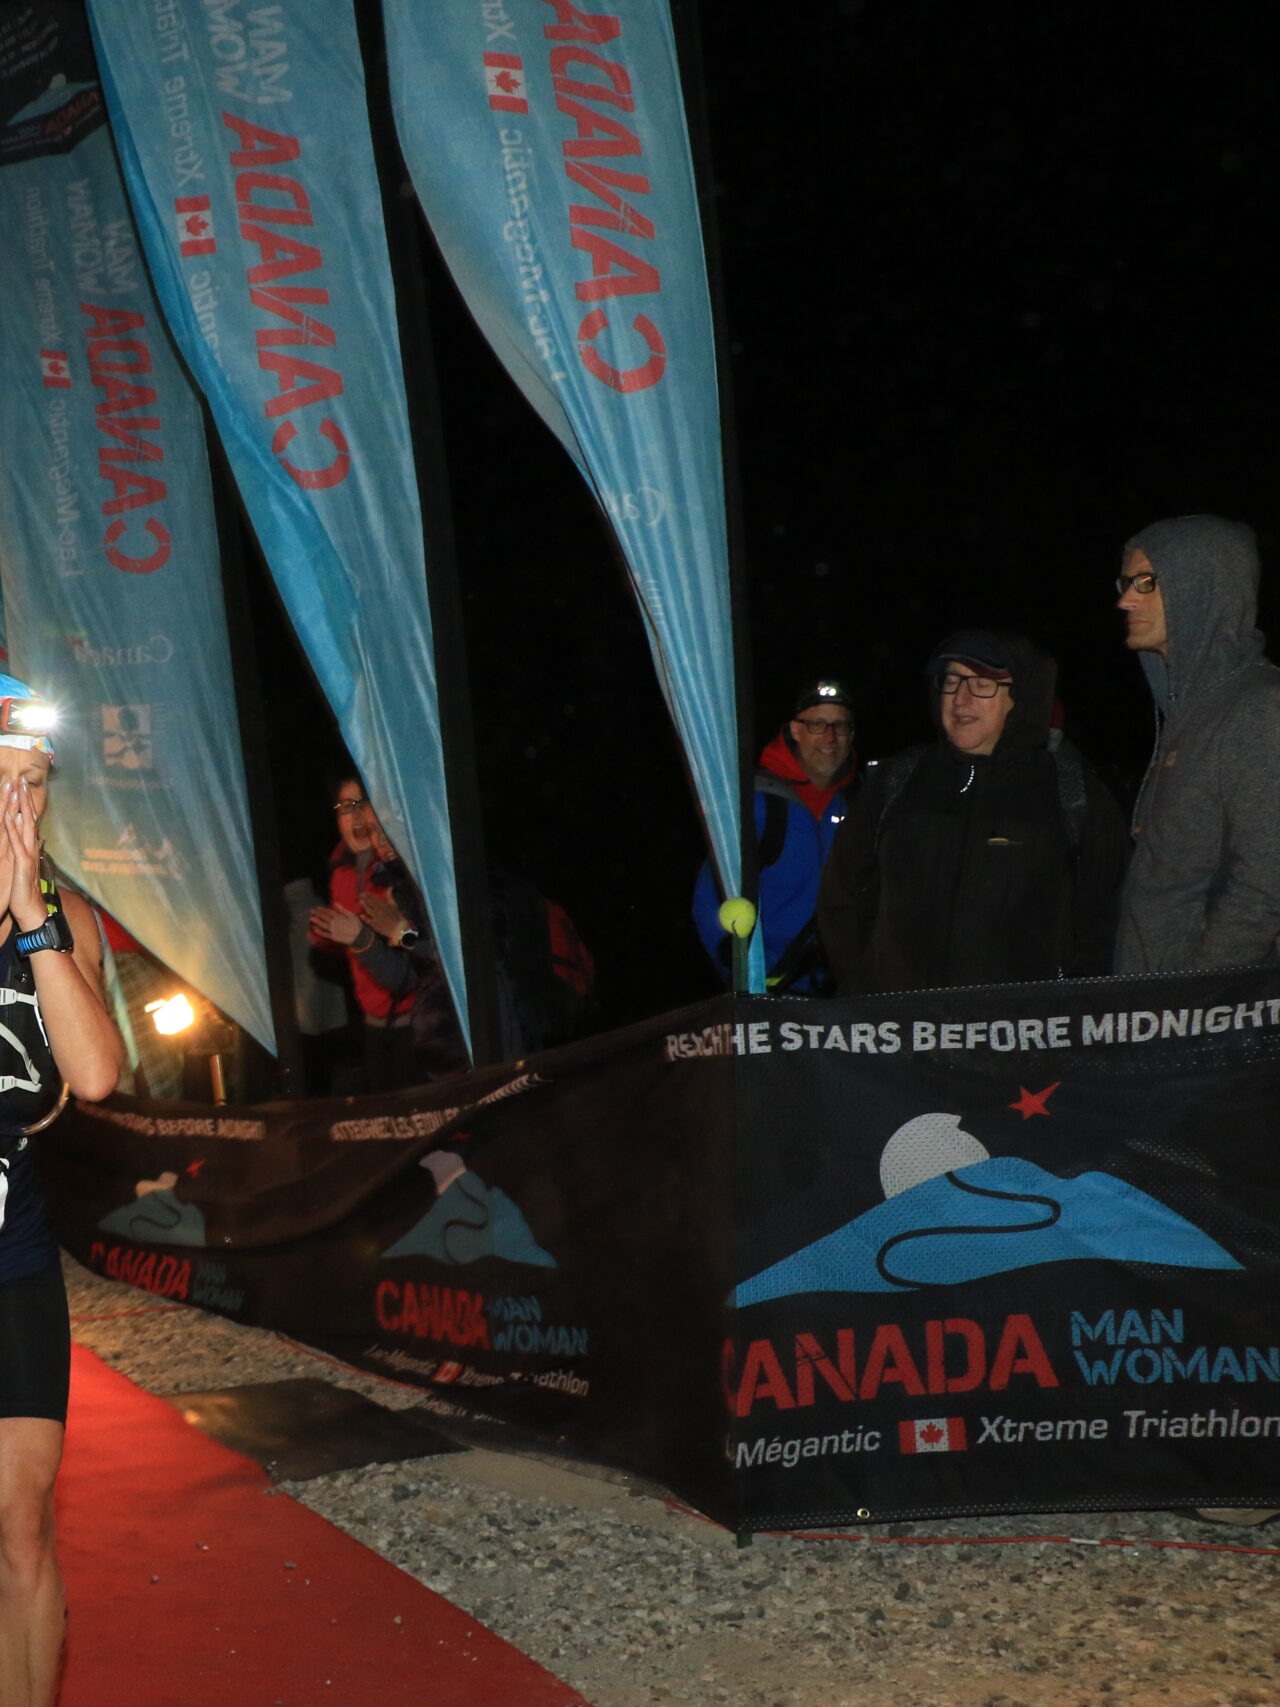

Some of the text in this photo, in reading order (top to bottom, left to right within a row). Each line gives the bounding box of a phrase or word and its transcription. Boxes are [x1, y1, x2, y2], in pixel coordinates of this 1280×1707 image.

[779, 1021, 902, 1054] STARS
[913, 1016, 1072, 1053] BEFORE
[375, 1280, 491, 1351] CANADA
[1070, 1308, 1185, 1347] MAN
[492, 1323, 589, 1357] WOMAN
[1072, 1346, 1280, 1387] WOMAN
[976, 1412, 1109, 1445] Xtreme
[1122, 1408, 1280, 1439] Triathlon
